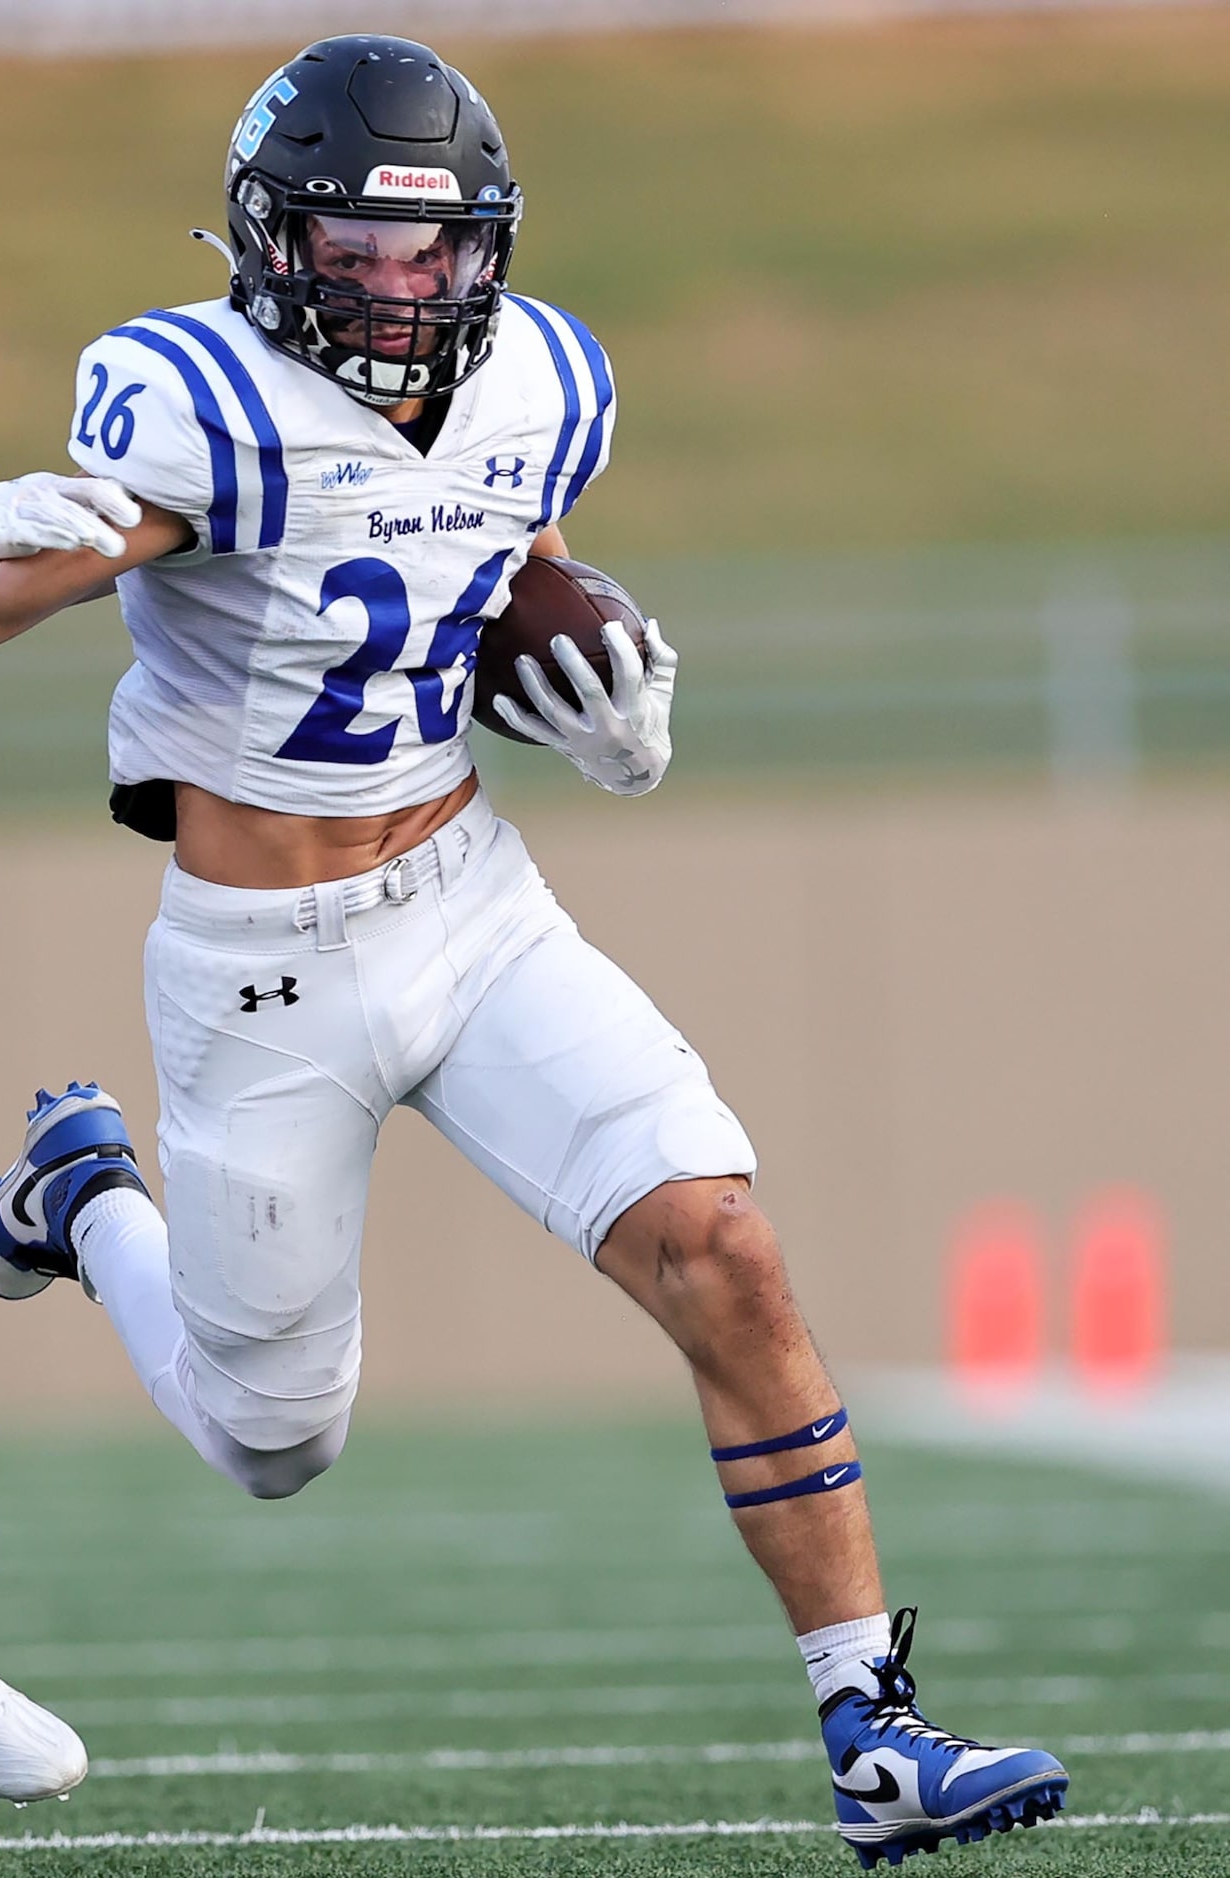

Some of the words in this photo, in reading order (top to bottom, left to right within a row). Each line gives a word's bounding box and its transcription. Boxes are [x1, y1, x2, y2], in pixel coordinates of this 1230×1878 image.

[379, 170, 450, 189] Riddell
[76, 362, 147, 461] 26
[367, 510, 425, 544] Byron
[431, 504, 485, 533] Nelson
[272, 547, 516, 765] 26
